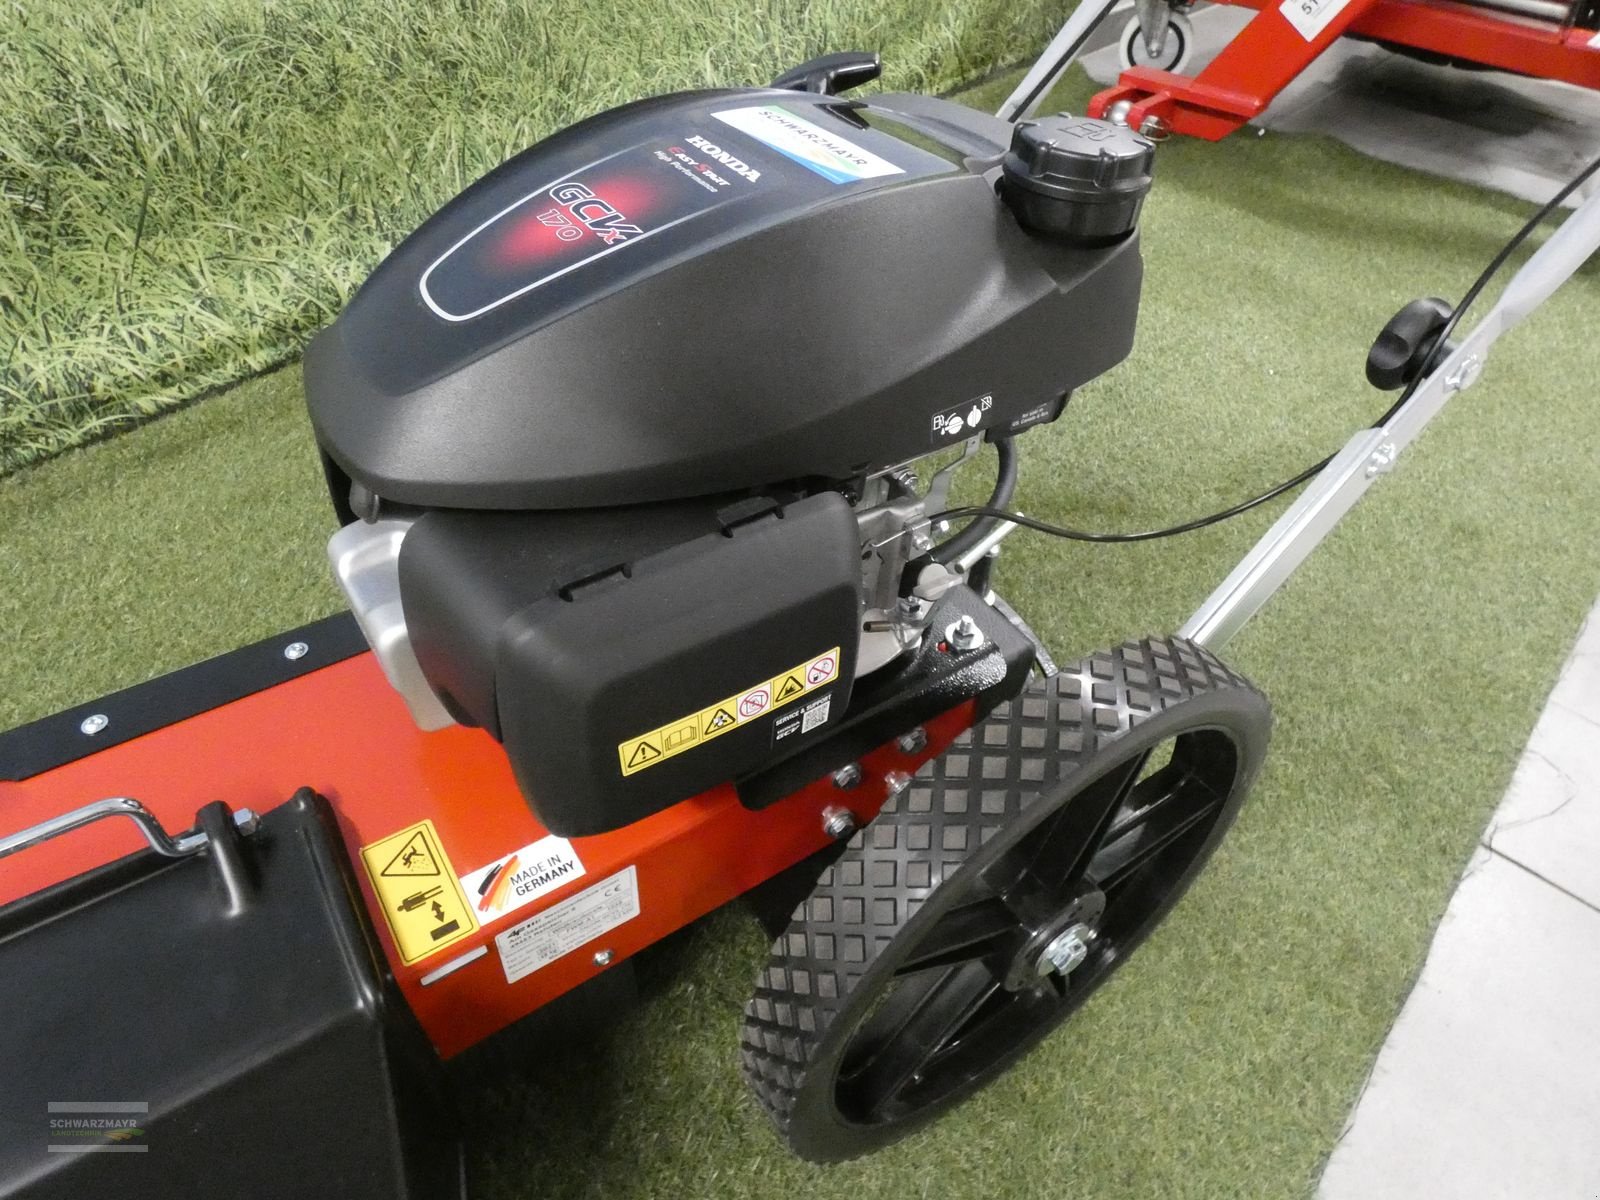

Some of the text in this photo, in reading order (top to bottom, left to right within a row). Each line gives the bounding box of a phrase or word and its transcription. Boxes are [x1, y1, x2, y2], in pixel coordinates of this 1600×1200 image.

[758, 110, 868, 166] SCHWARZMAYR
[653, 150, 673, 163] High
[684, 134, 761, 183] HONDA
[536, 208, 583, 242] 170
[775, 710, 800, 727] SERVICE
[806, 694, 832, 711] SUPPORT
[510, 854, 563, 886] MADE IN
[515, 860, 576, 896] GERMANY
